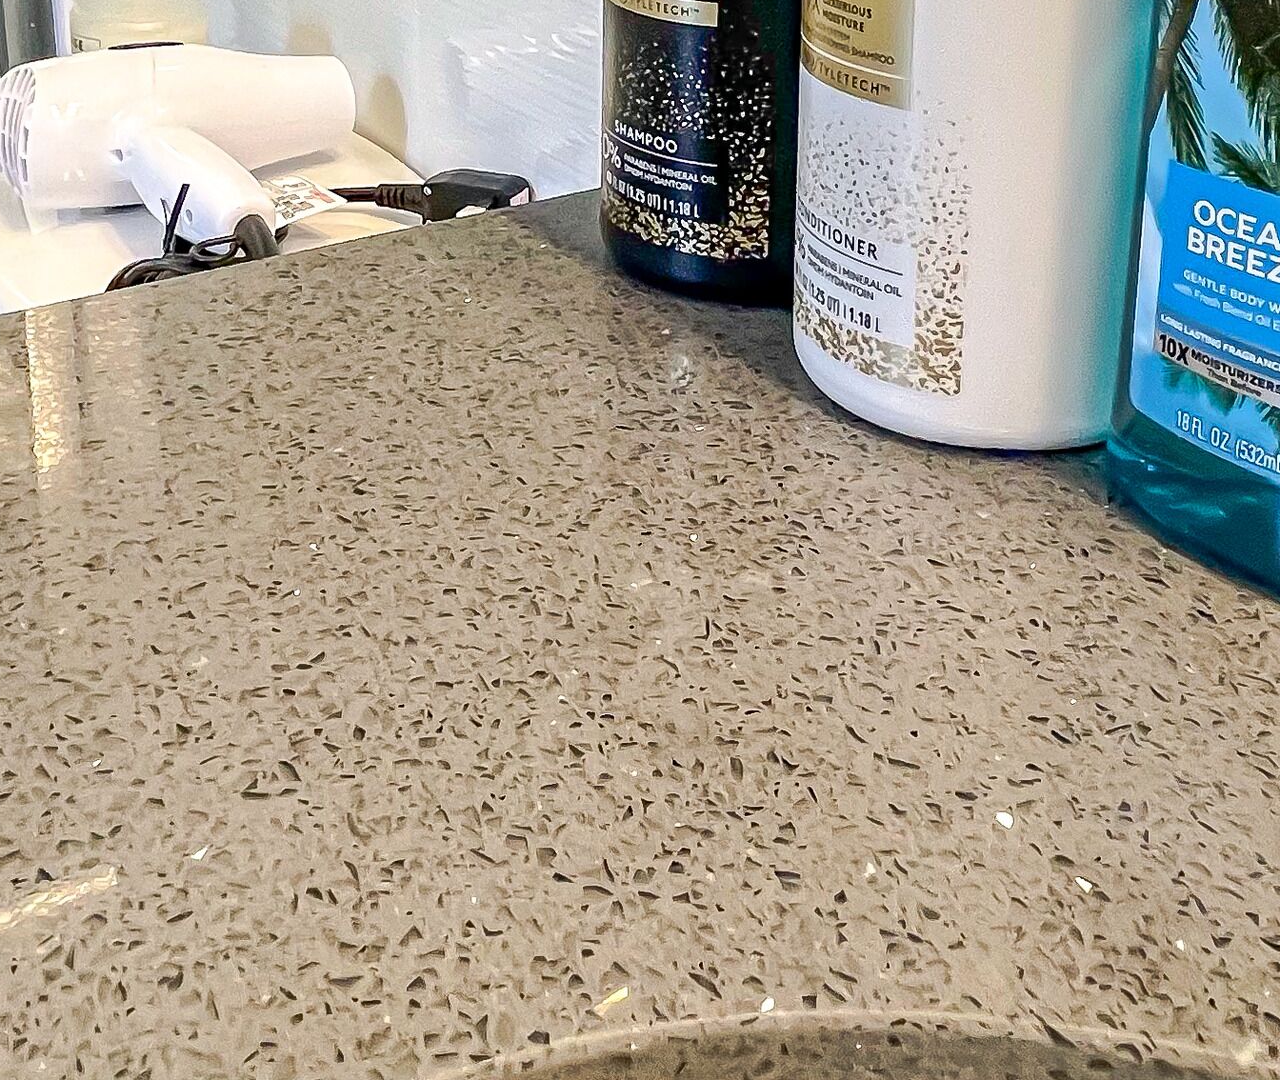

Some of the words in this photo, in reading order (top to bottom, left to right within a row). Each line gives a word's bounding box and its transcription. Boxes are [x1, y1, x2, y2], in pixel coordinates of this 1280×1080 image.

[615, 120, 677, 153] SHAMPOO
[701, 175, 717, 185] OIL
[669, 200, 691, 216] 1.18
[694, 204, 700, 218] L
[798, 197, 878, 261] NDITIONER
[884, 283, 902, 298] OIL
[1183, 269, 1227, 295] GENTLE
[1230, 288, 1265, 308] BODY
[850, 307, 871, 329] 1.18
[876, 317, 882, 333] L
[1160, 334, 1189, 366] 10X
[1183, 325, 1222, 350] LASTING
[1176, 410, 1189, 432] 18
[1192, 422, 1206, 441] FL
[1210, 428, 1232, 452] OZ
